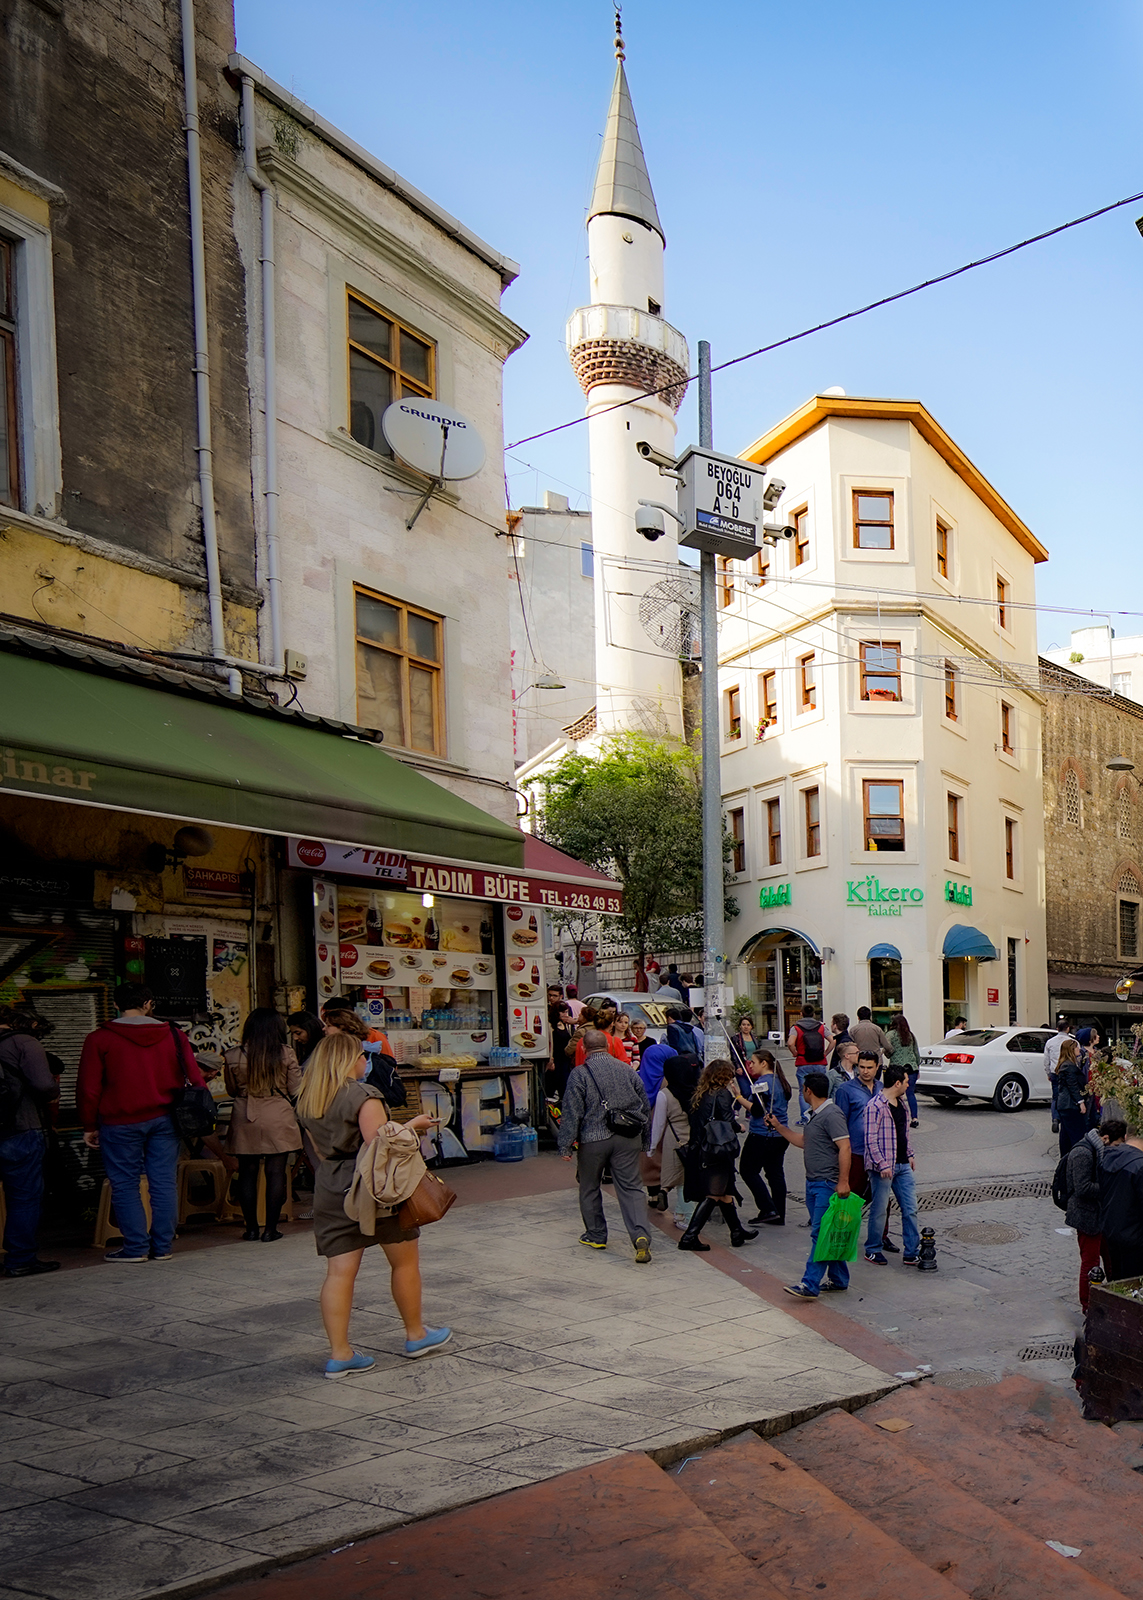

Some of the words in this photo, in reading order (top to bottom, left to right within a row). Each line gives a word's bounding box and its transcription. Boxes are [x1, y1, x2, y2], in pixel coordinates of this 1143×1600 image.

[400, 405, 467, 429] GRUNDIG
[707, 463, 751, 488] BEYOĞLU
[716, 480, 741, 502] 064
[712, 497, 722, 514] A
[732, 502, 739, 518] b
[720, 520, 752, 536] MOBESE
[0, 747, 97, 791] inar
[362, 849, 407, 868] TADI
[375, 867, 394, 878] TEL
[411, 865, 473, 895] TADIM
[484, 874, 530, 901] BÜFE
[540, 889, 562, 906] TEL
[571, 893, 590, 909] 243
[592, 896, 605, 910] 49
[607, 898, 620, 912] 53
[759, 883, 792, 908] falafel
[847, 876, 924, 902] Kikero
[868, 904, 902, 916] falafel
